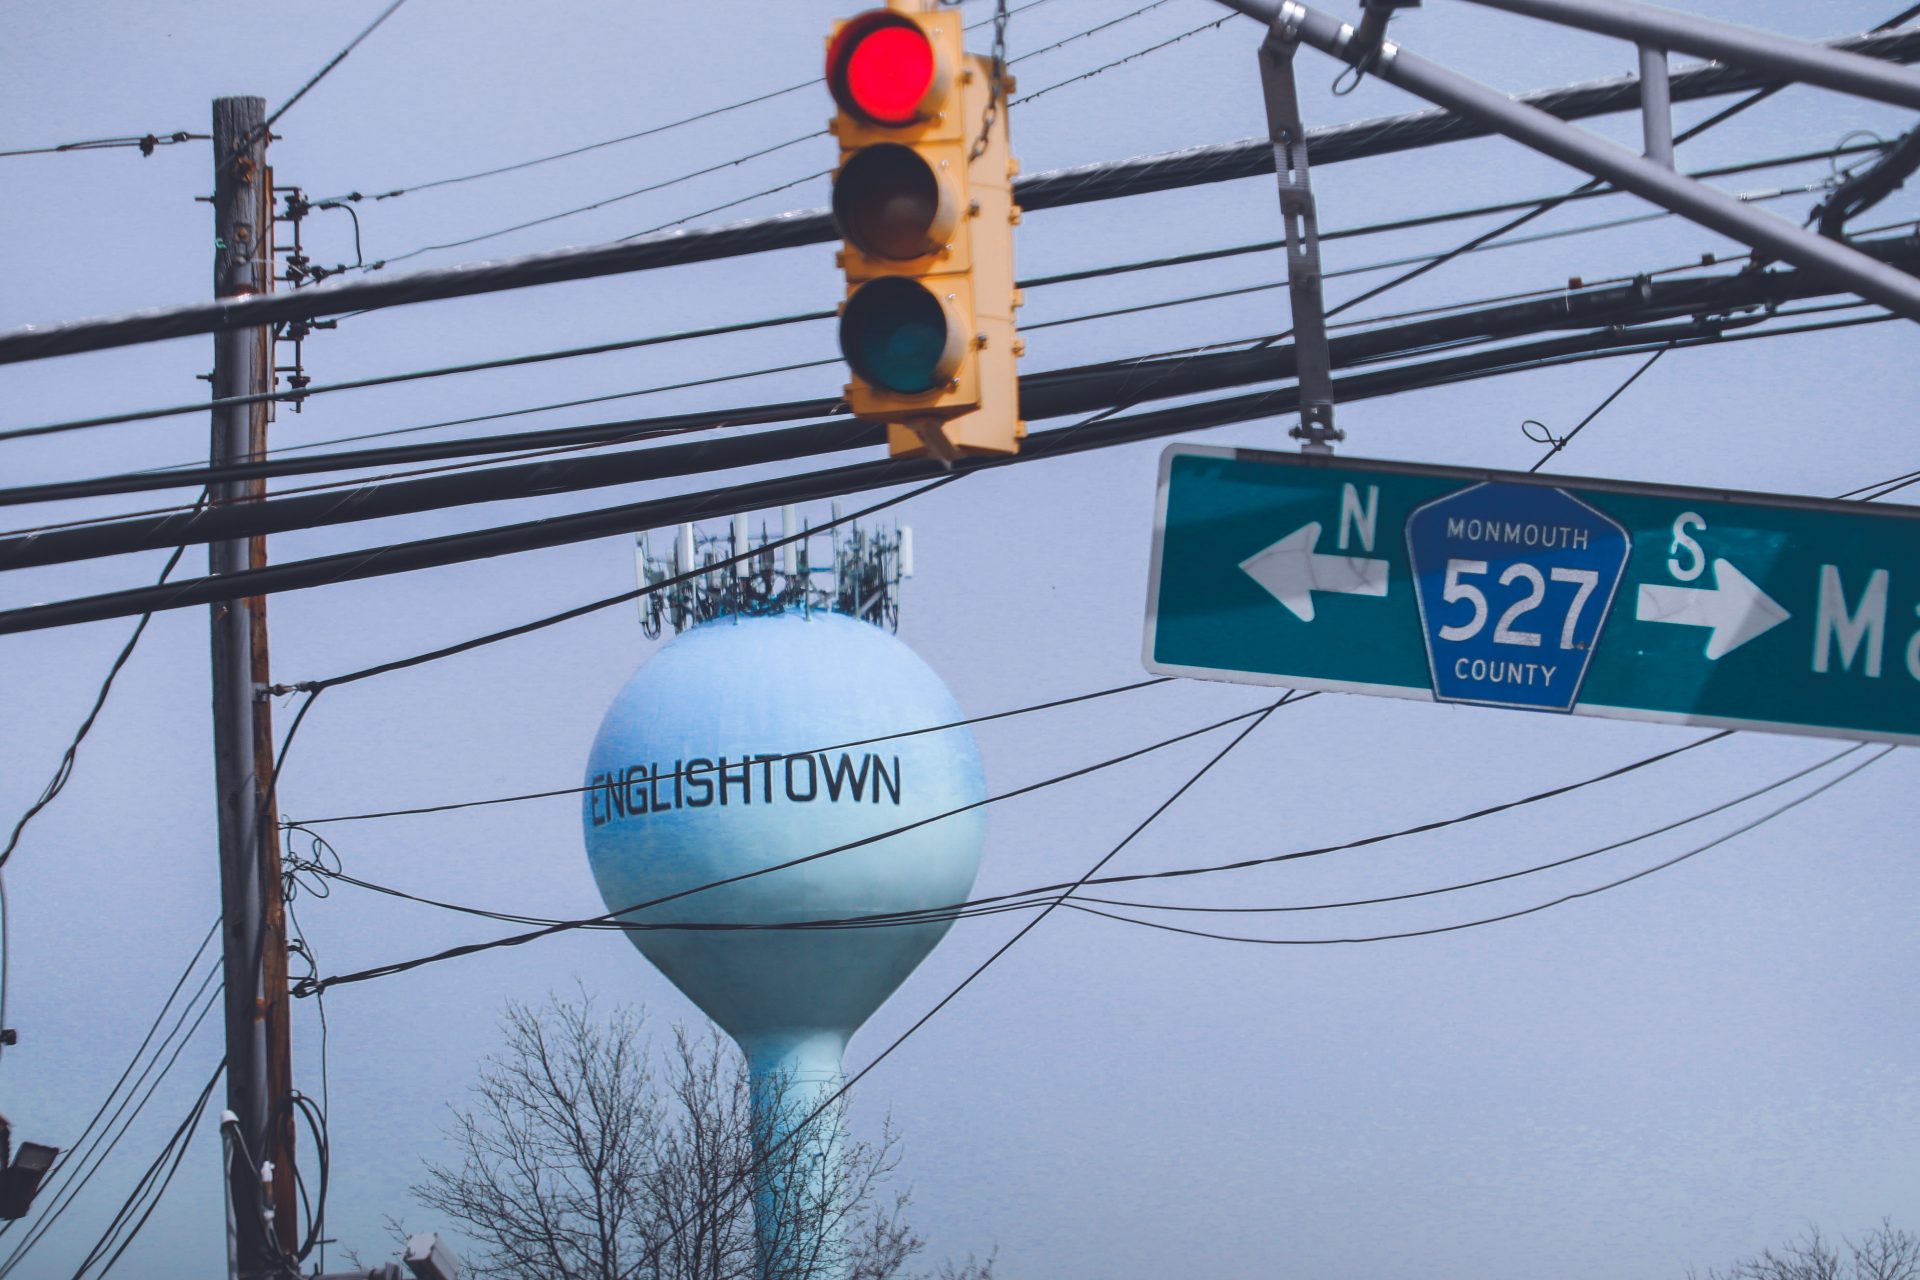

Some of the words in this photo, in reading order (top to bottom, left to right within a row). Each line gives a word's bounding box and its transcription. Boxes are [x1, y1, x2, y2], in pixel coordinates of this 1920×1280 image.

[1338, 482, 1379, 551] N
[1447, 517, 1589, 550] MONMOUTH
[1668, 511, 1706, 581] S
[1438, 559, 1600, 651] 527
[1454, 657, 1557, 687] COUNTY
[591, 752, 900, 827] ENGLISHTOWN
